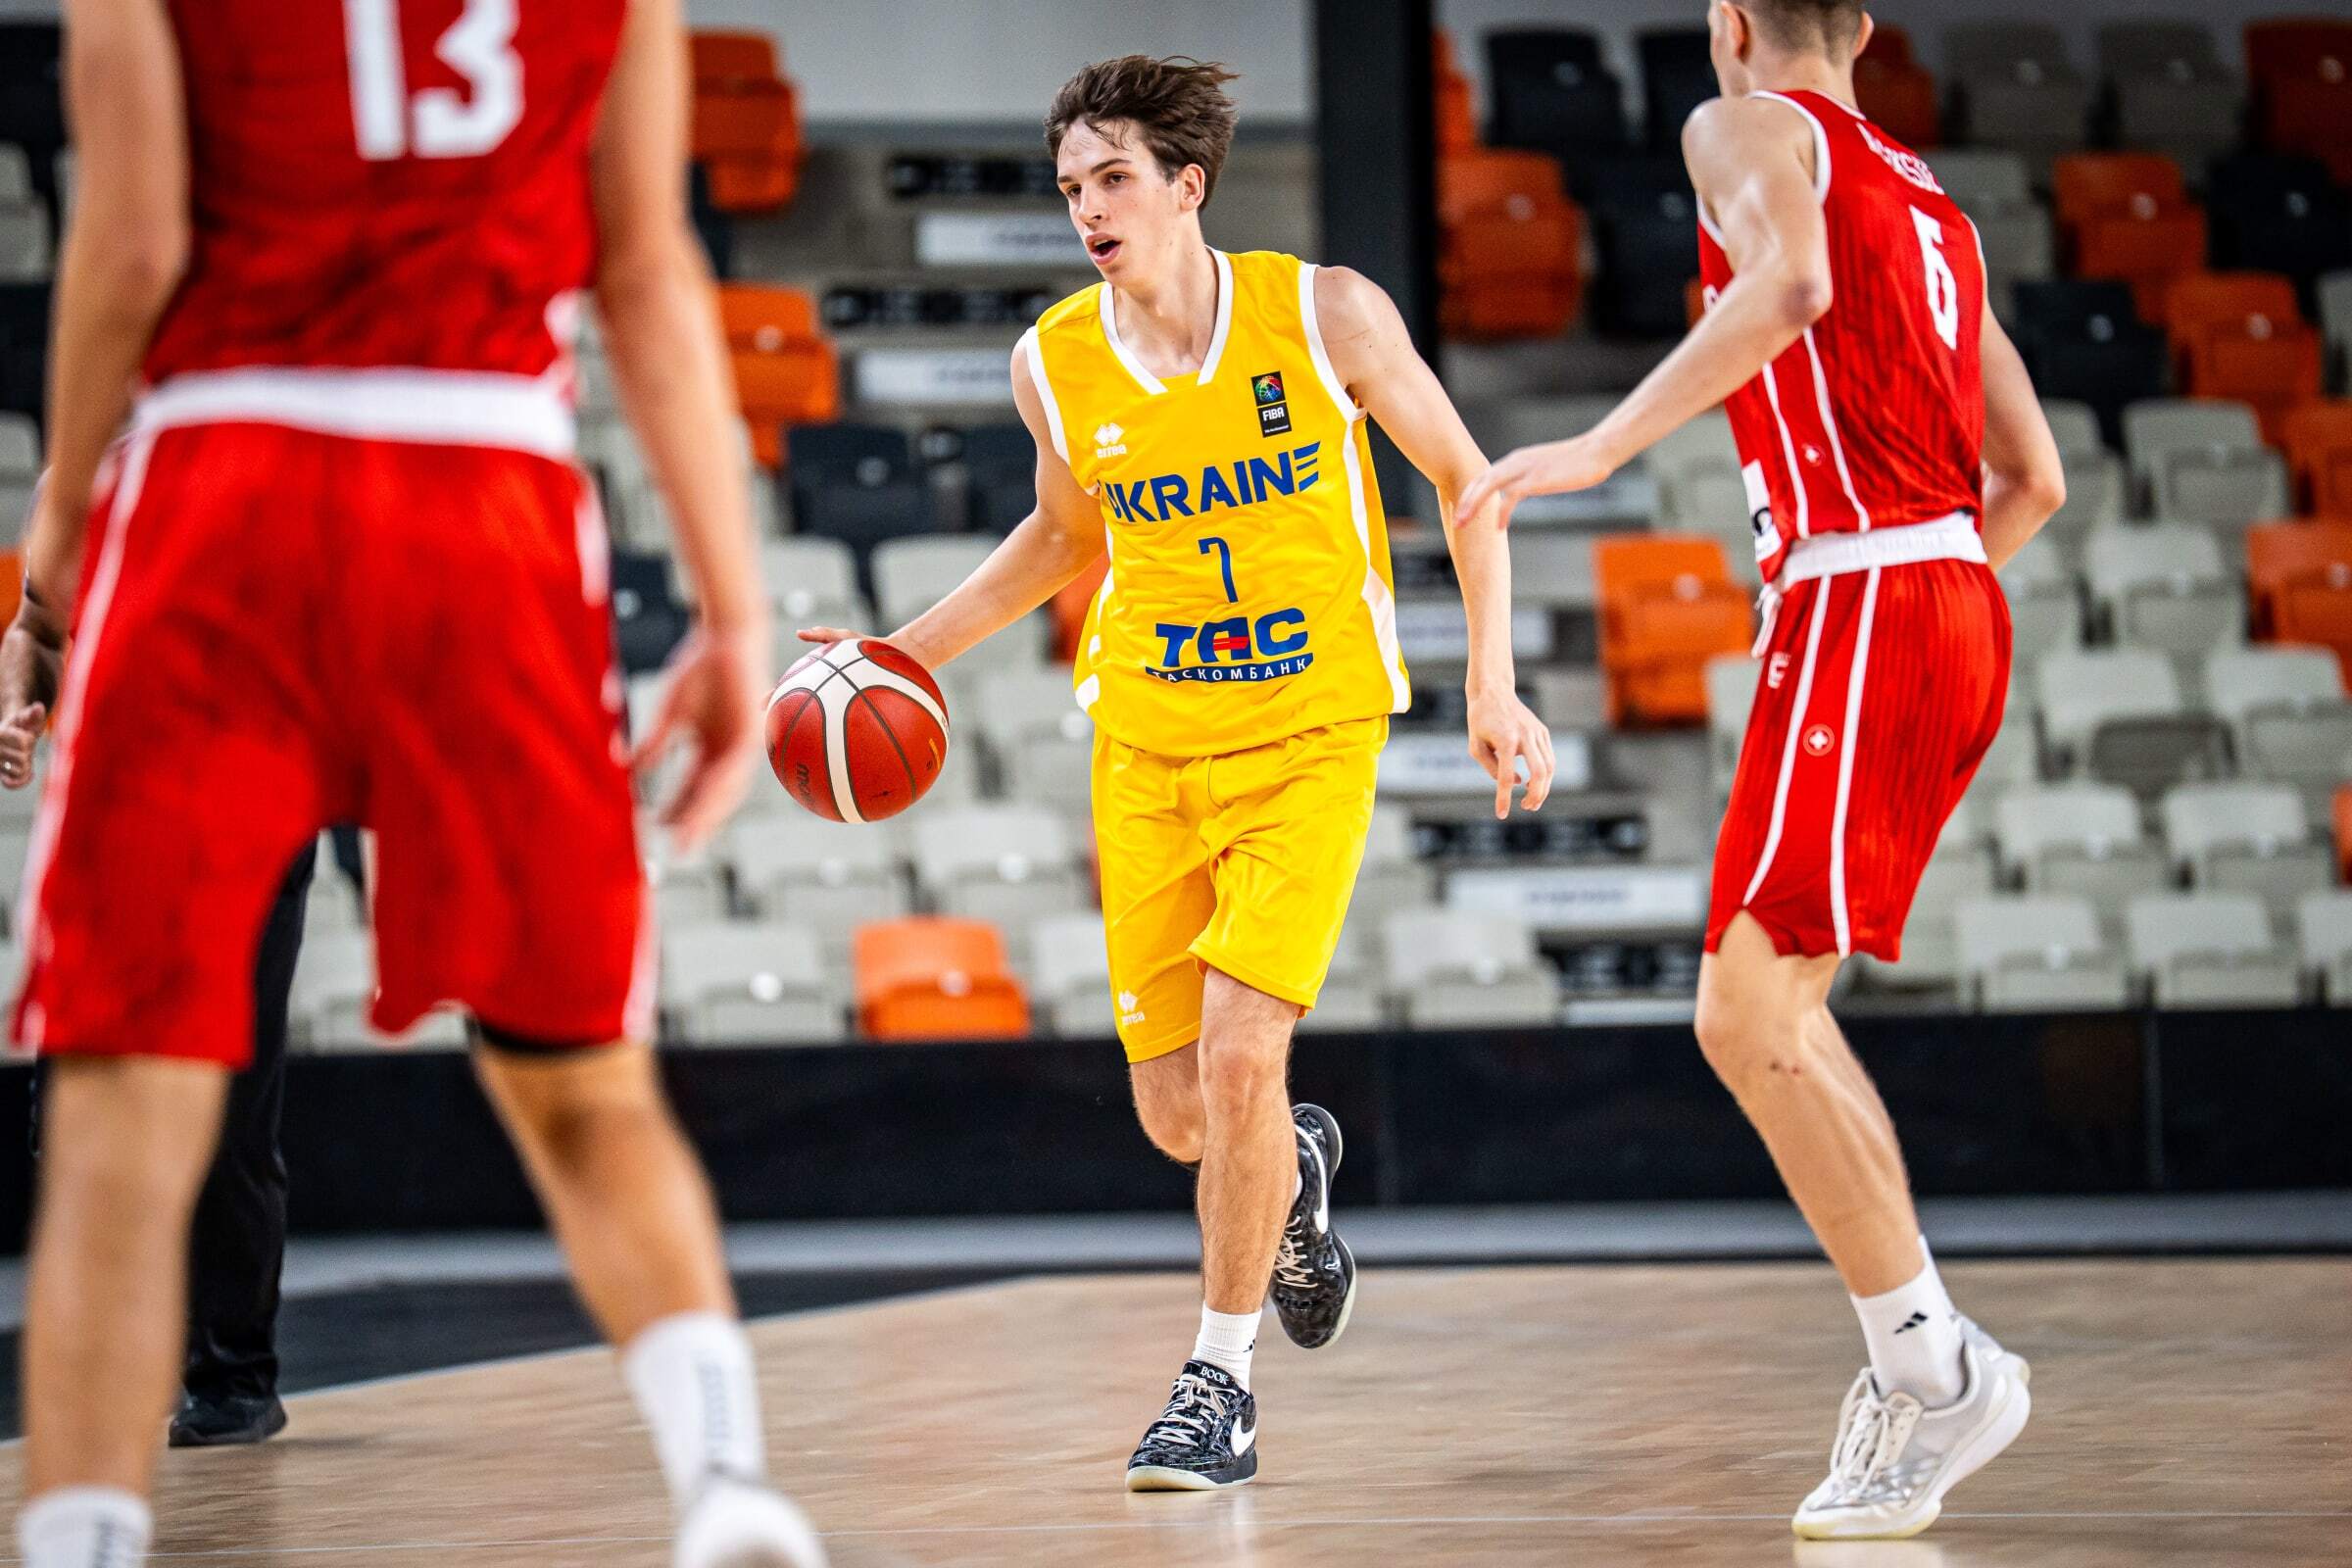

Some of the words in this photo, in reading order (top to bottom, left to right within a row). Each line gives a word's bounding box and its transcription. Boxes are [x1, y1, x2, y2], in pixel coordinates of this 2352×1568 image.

[342, 0, 526, 162] 13
[1909, 204, 1958, 351] 6
[1262, 407, 1285, 421] FIBA
[1198, 537, 1239, 603] 7
[1200, 1365, 1230, 1385] BOOK
